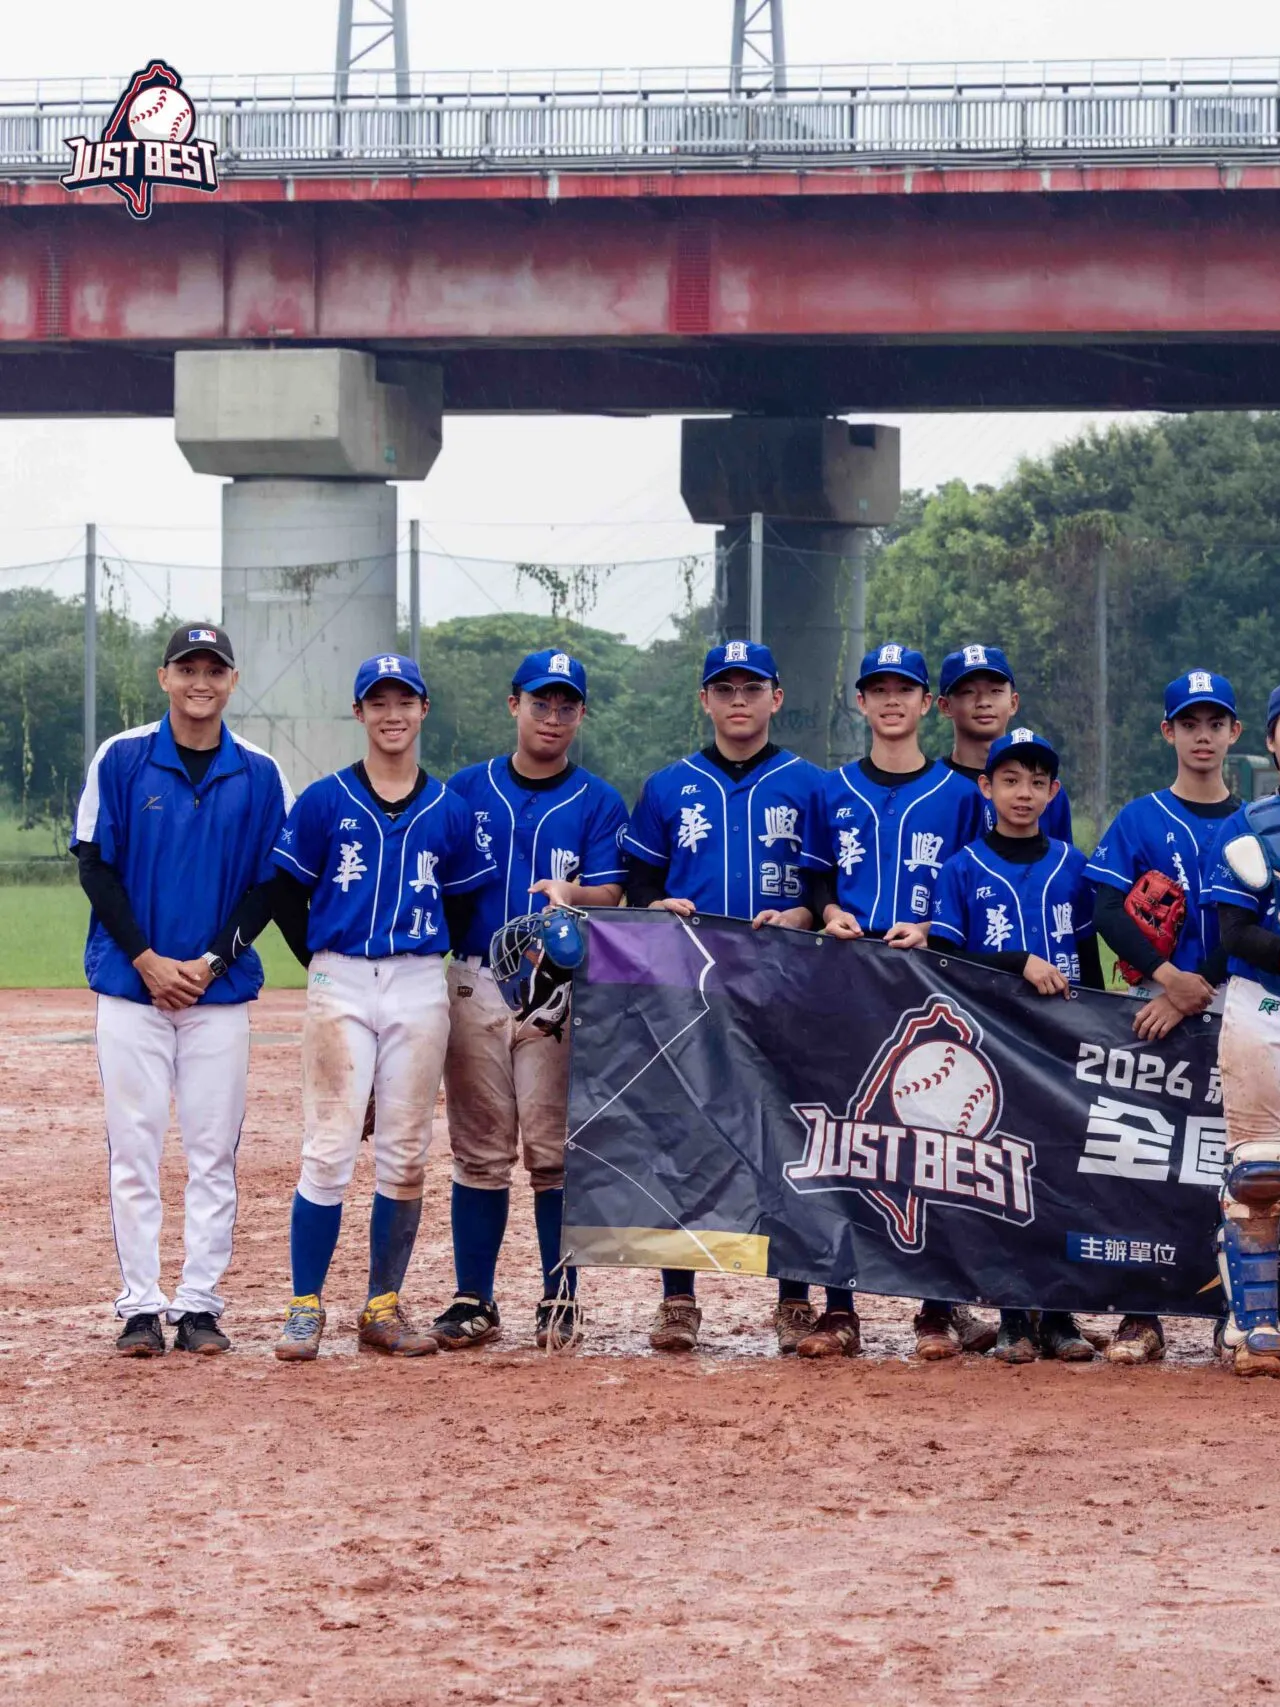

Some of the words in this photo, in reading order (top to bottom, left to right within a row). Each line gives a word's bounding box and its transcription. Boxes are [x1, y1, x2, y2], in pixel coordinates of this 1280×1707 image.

[724, 641, 750, 663] H
[877, 644, 903, 665] H
[963, 644, 988, 667] H
[376, 656, 402, 675] H
[547, 653, 571, 677] H
[1188, 671, 1213, 694] H
[759, 860, 802, 898] 25
[911, 883, 931, 917] 6
[1076, 1042, 1193, 1099] 2026
[788, 1108, 907, 1183] JUST
[911, 1128, 1030, 1213] BEST
[1080, 1236, 1177, 1266] 主辦單位
